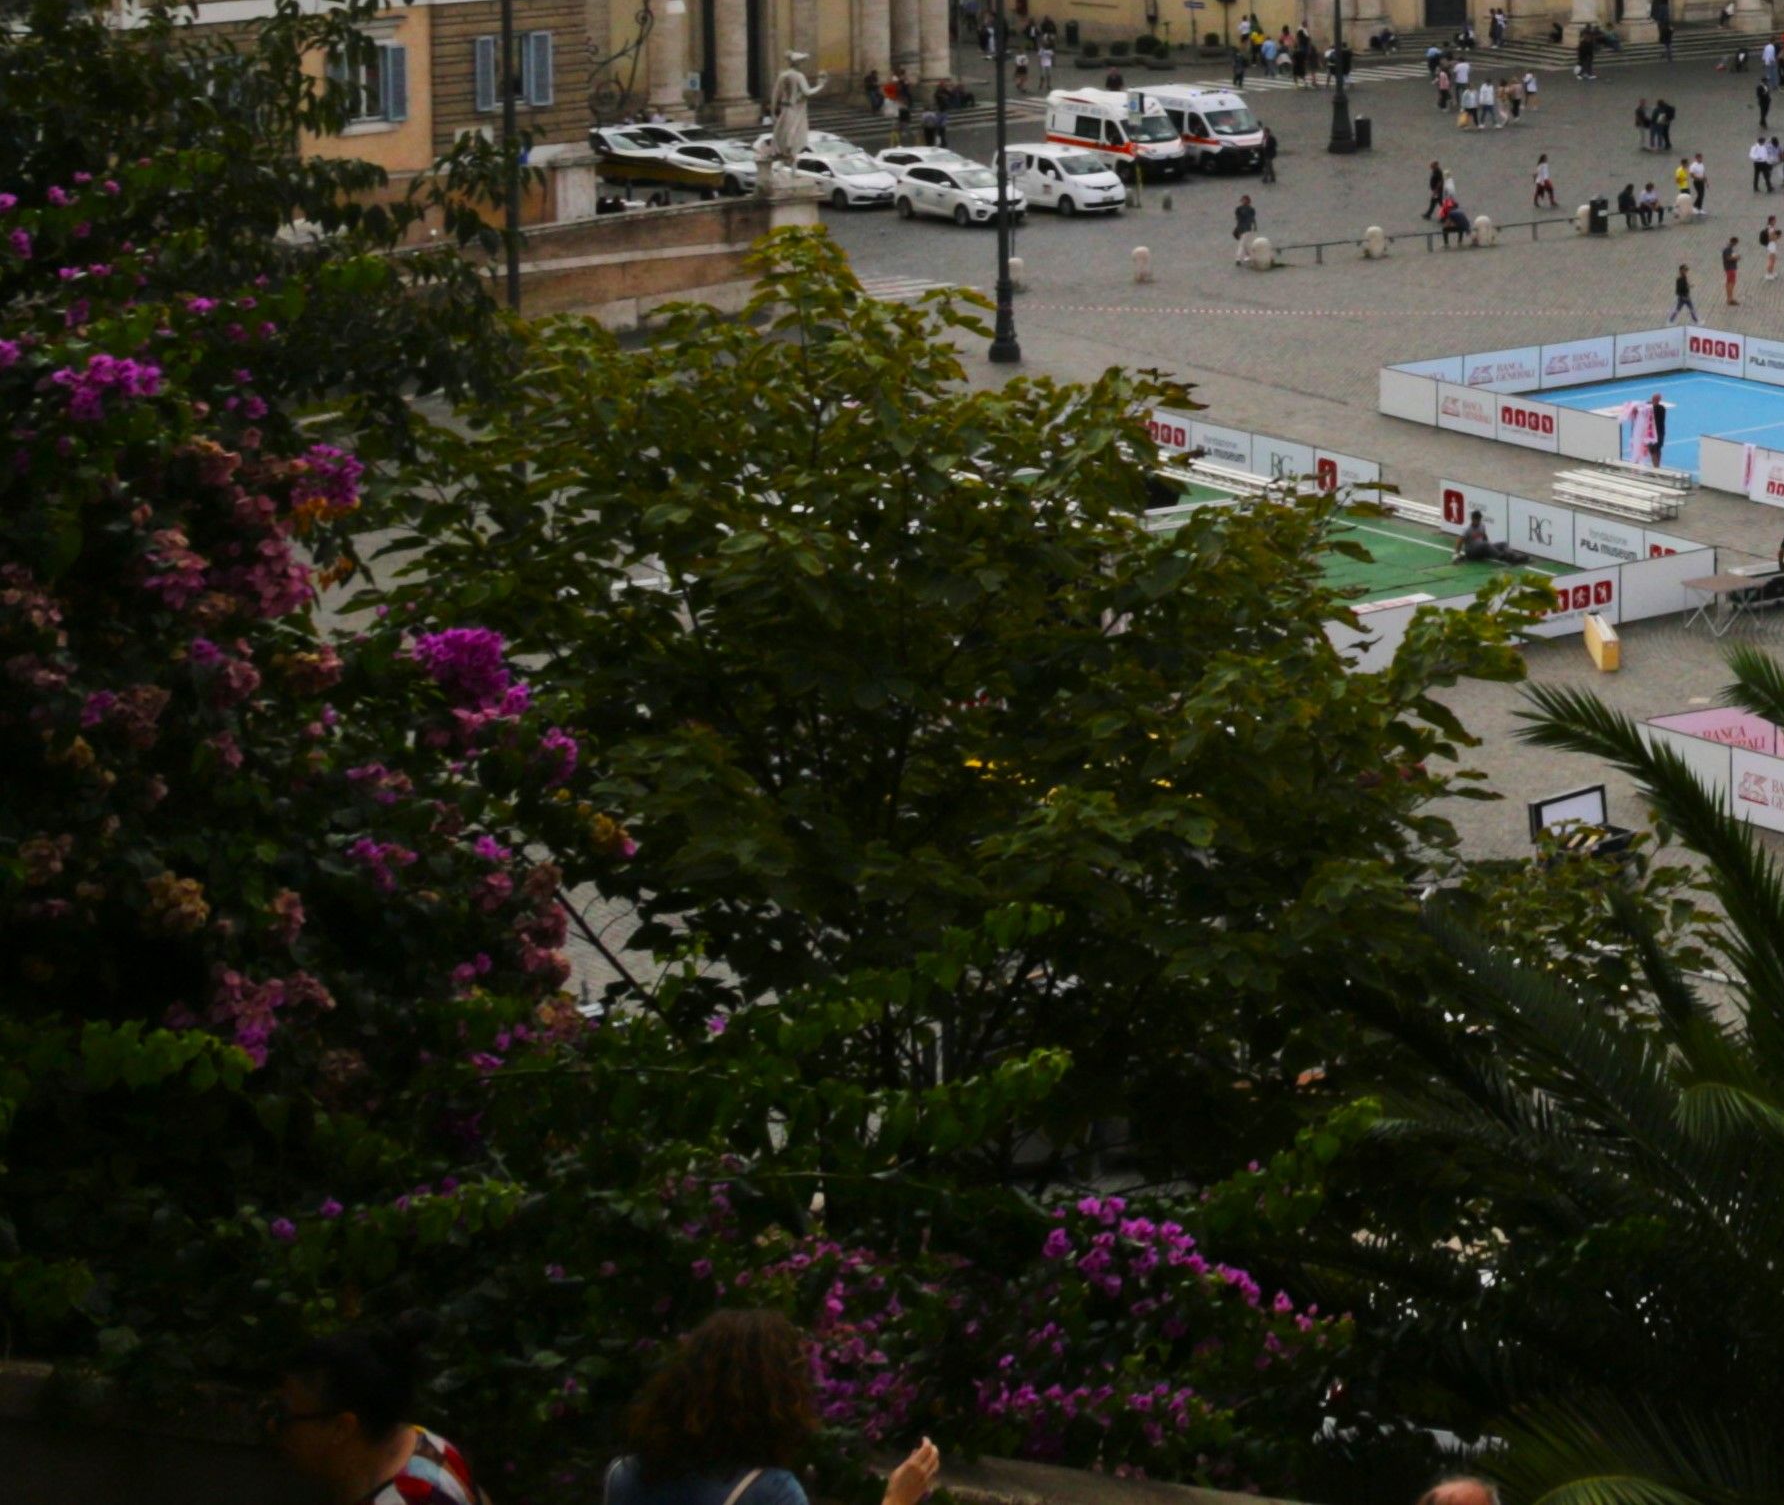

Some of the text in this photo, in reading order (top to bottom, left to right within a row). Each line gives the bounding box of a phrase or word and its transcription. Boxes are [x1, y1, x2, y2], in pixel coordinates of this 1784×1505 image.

[1572, 351, 1599, 362] BANCA
[1496, 362, 1525, 373] BANCA
[1571, 359, 1610, 372] GENERALI
[1495, 369, 1536, 383] GENERALI
[1528, 515, 1552, 546] RG
